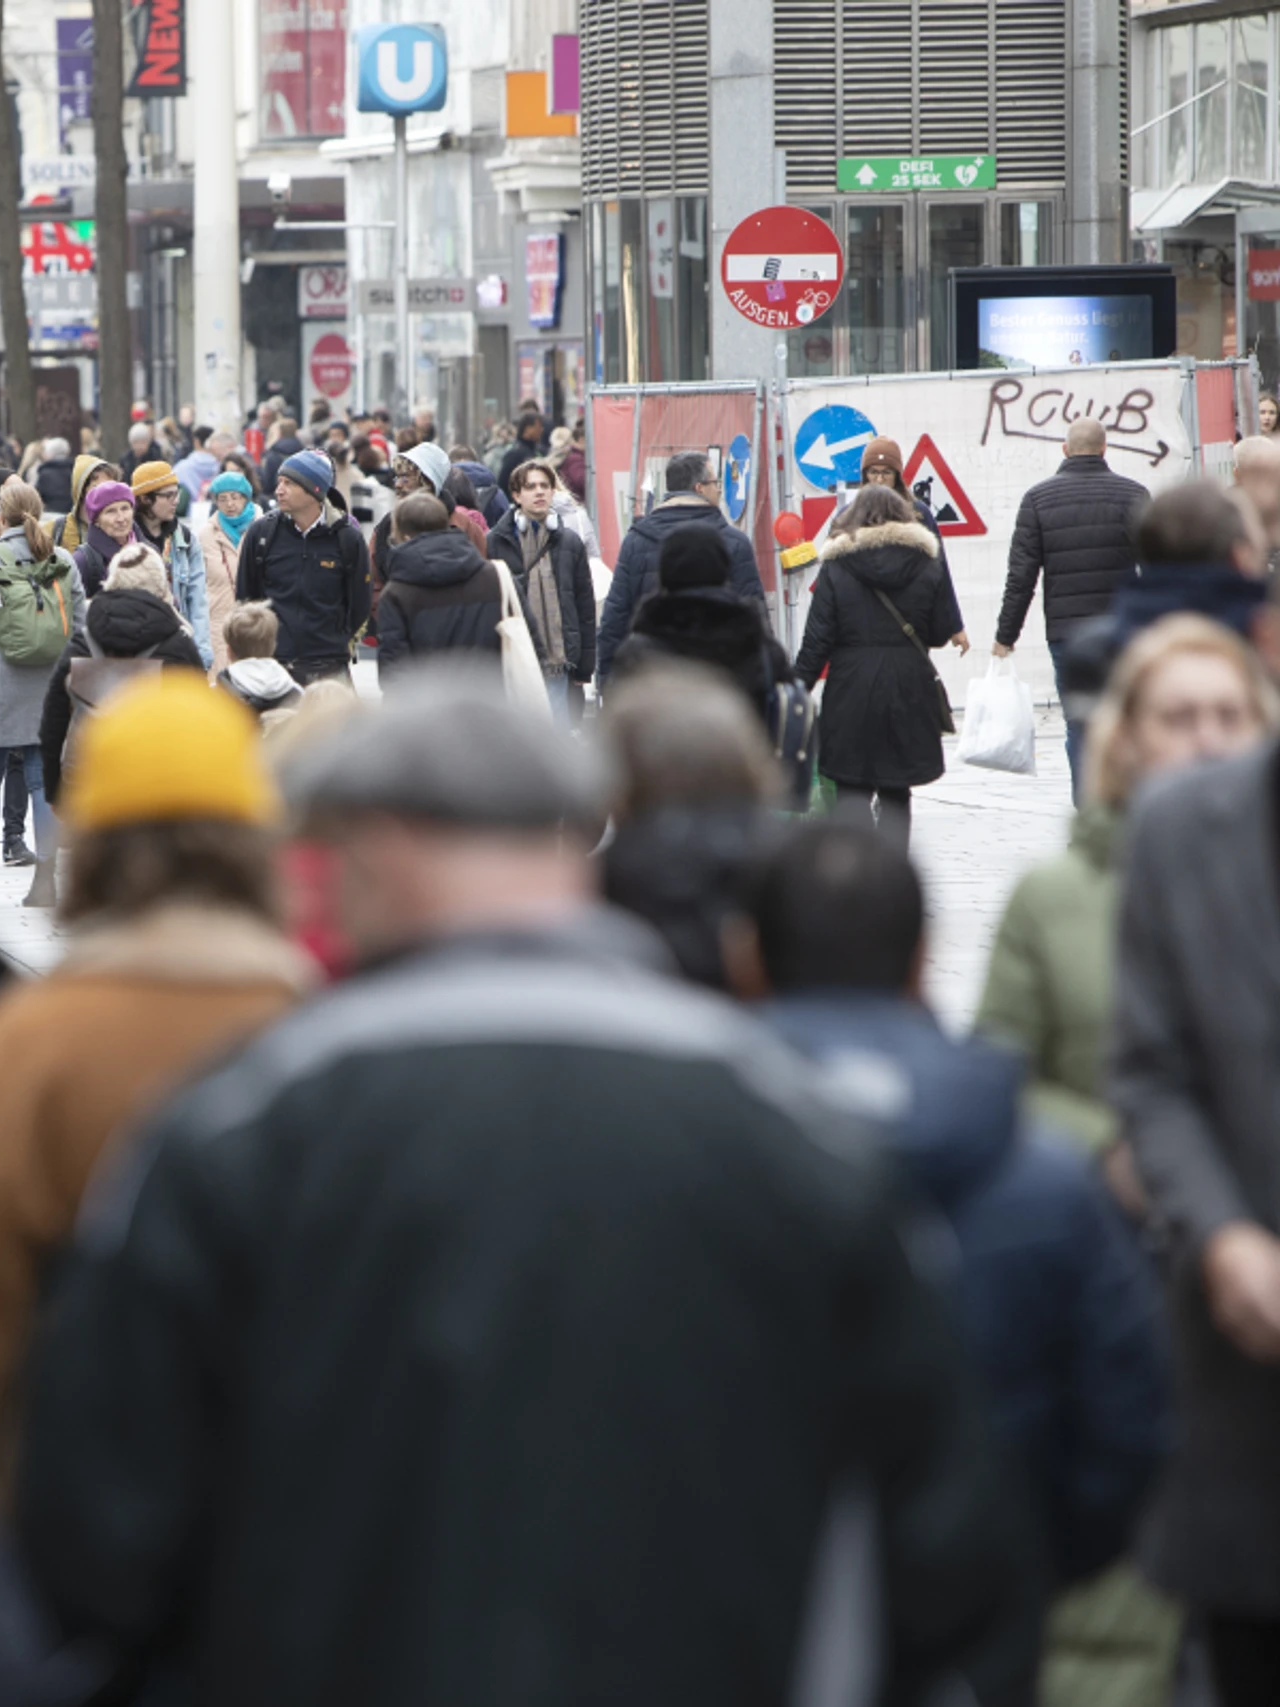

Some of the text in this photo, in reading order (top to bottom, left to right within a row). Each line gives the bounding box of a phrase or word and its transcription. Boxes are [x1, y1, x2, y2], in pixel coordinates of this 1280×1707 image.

[377, 41, 433, 101] U
[900, 161, 933, 173] DEFI
[892, 173, 942, 186] 25 SEK
[730, 288, 794, 326] AUSGEN.
[990, 313, 1034, 328] Bester
[1037, 312, 1089, 327] Genuss
